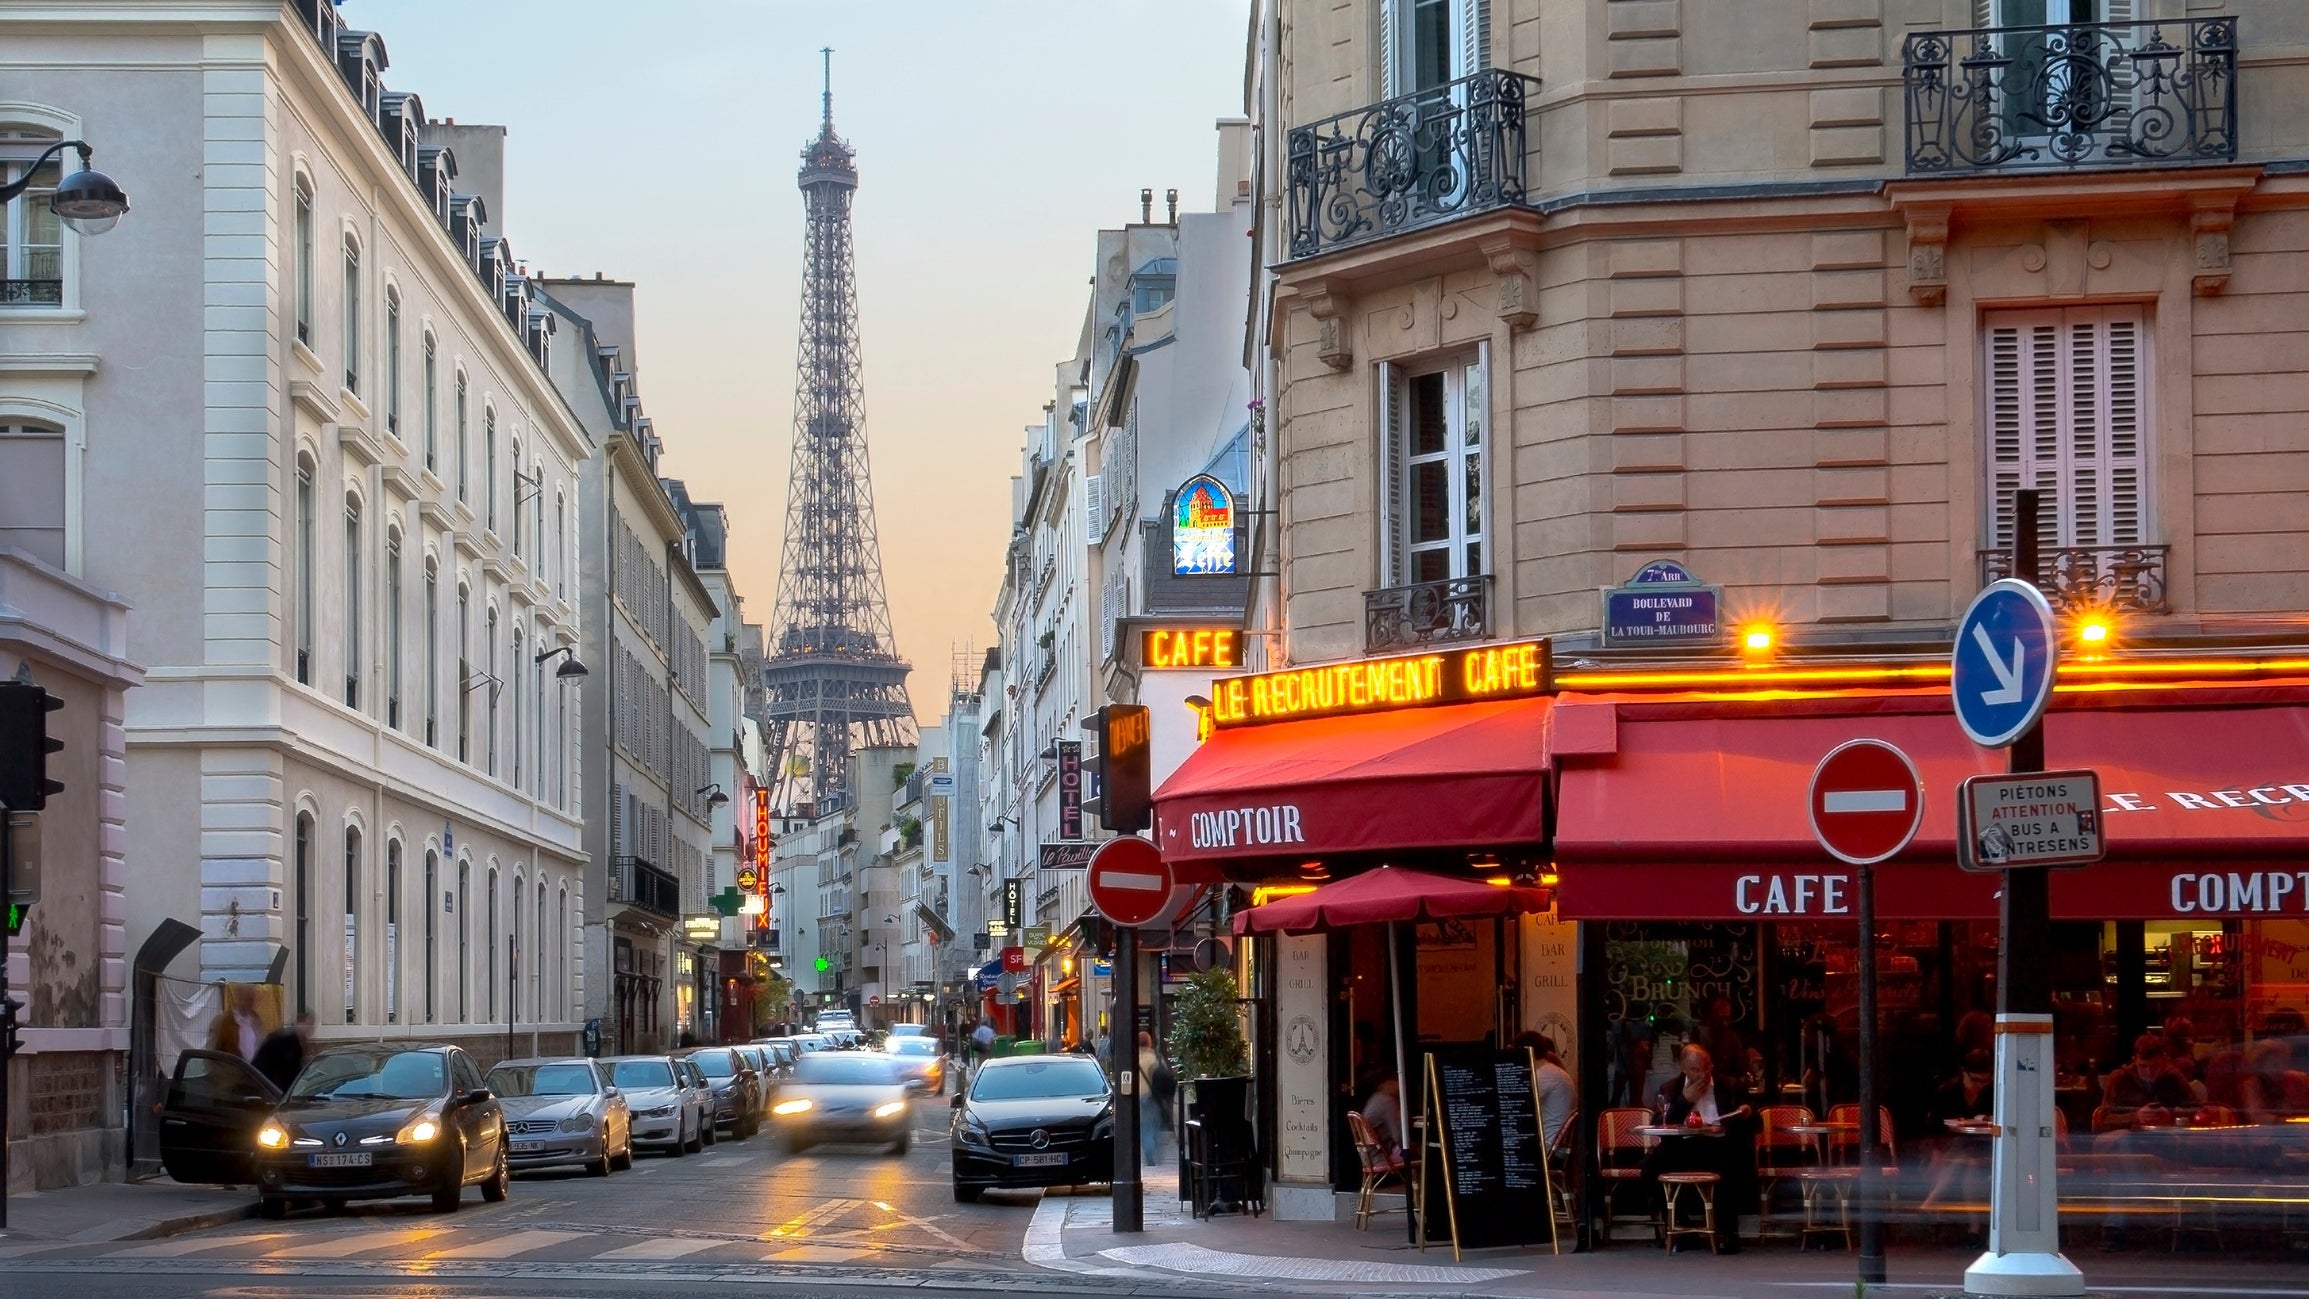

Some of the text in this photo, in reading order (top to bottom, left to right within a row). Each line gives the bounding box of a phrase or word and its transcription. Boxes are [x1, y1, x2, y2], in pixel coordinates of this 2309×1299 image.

[1632, 597, 1693, 609] BOULEVARD
[1655, 611, 1671, 622] DE
[1610, 623, 1716, 637] LA TOUR-MAUBOURG
[1151, 631, 1233, 667] CAFE
[1213, 645, 1541, 720] LE RECRUTEMENT CAFE
[1061, 755, 1080, 837] HOTEL
[2000, 785, 2068, 801] PIÉTONS
[2102, 792, 2157, 813] E
[1992, 802, 2078, 820] ATTENTION
[1191, 805, 1305, 849] COMPTOIR
[2011, 822, 2060, 837] BUS A
[2006, 837, 2090, 855] NTRESENS
[1736, 875, 1849, 914] CAFE
[1008, 882, 1017, 925] HÔTEL
[1292, 950, 1310, 961] BAR
[1541, 943, 1566, 957] BAR
[1288, 978, 1314, 989] GRILL
[1535, 975, 1569, 988] GRILL
[1630, 975, 1732, 1001] BRUNCH
[1291, 1095, 1315, 1106] Bières
[1285, 1120, 1318, 1132] Cocktails
[316, 1156, 329, 1166] NS
